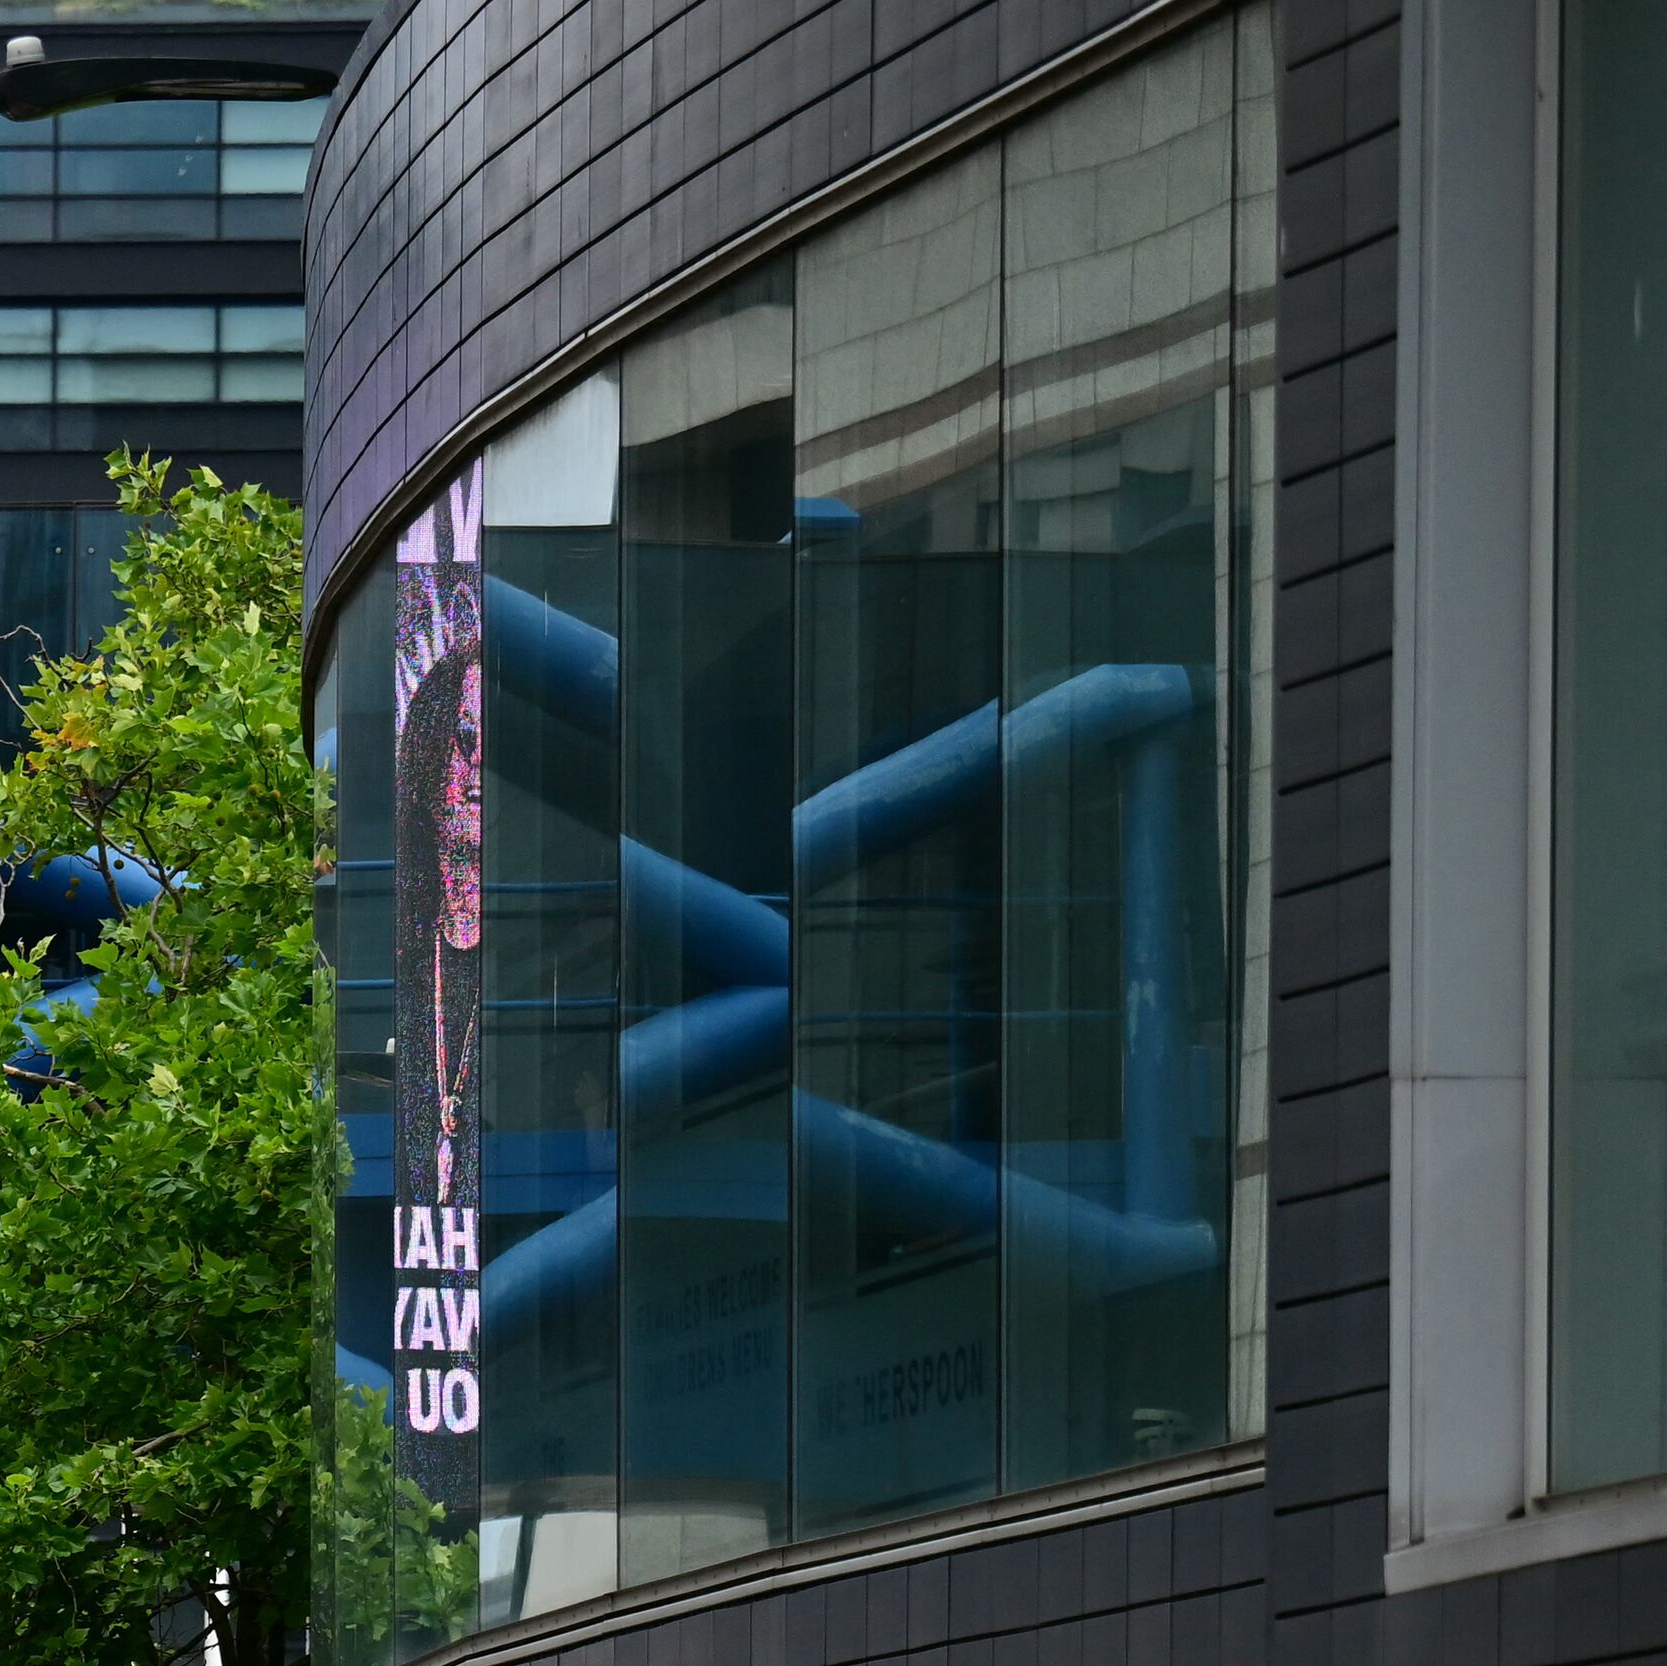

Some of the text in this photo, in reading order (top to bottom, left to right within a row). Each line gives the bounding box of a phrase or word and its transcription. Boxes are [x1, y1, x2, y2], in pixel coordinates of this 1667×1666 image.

[636, 1257, 781, 1345] FAMIIES WELCOME
[645, 1327, 773, 1406] CHLDRENS MENU
[817, 1340, 984, 1441] WEHERSPOON
